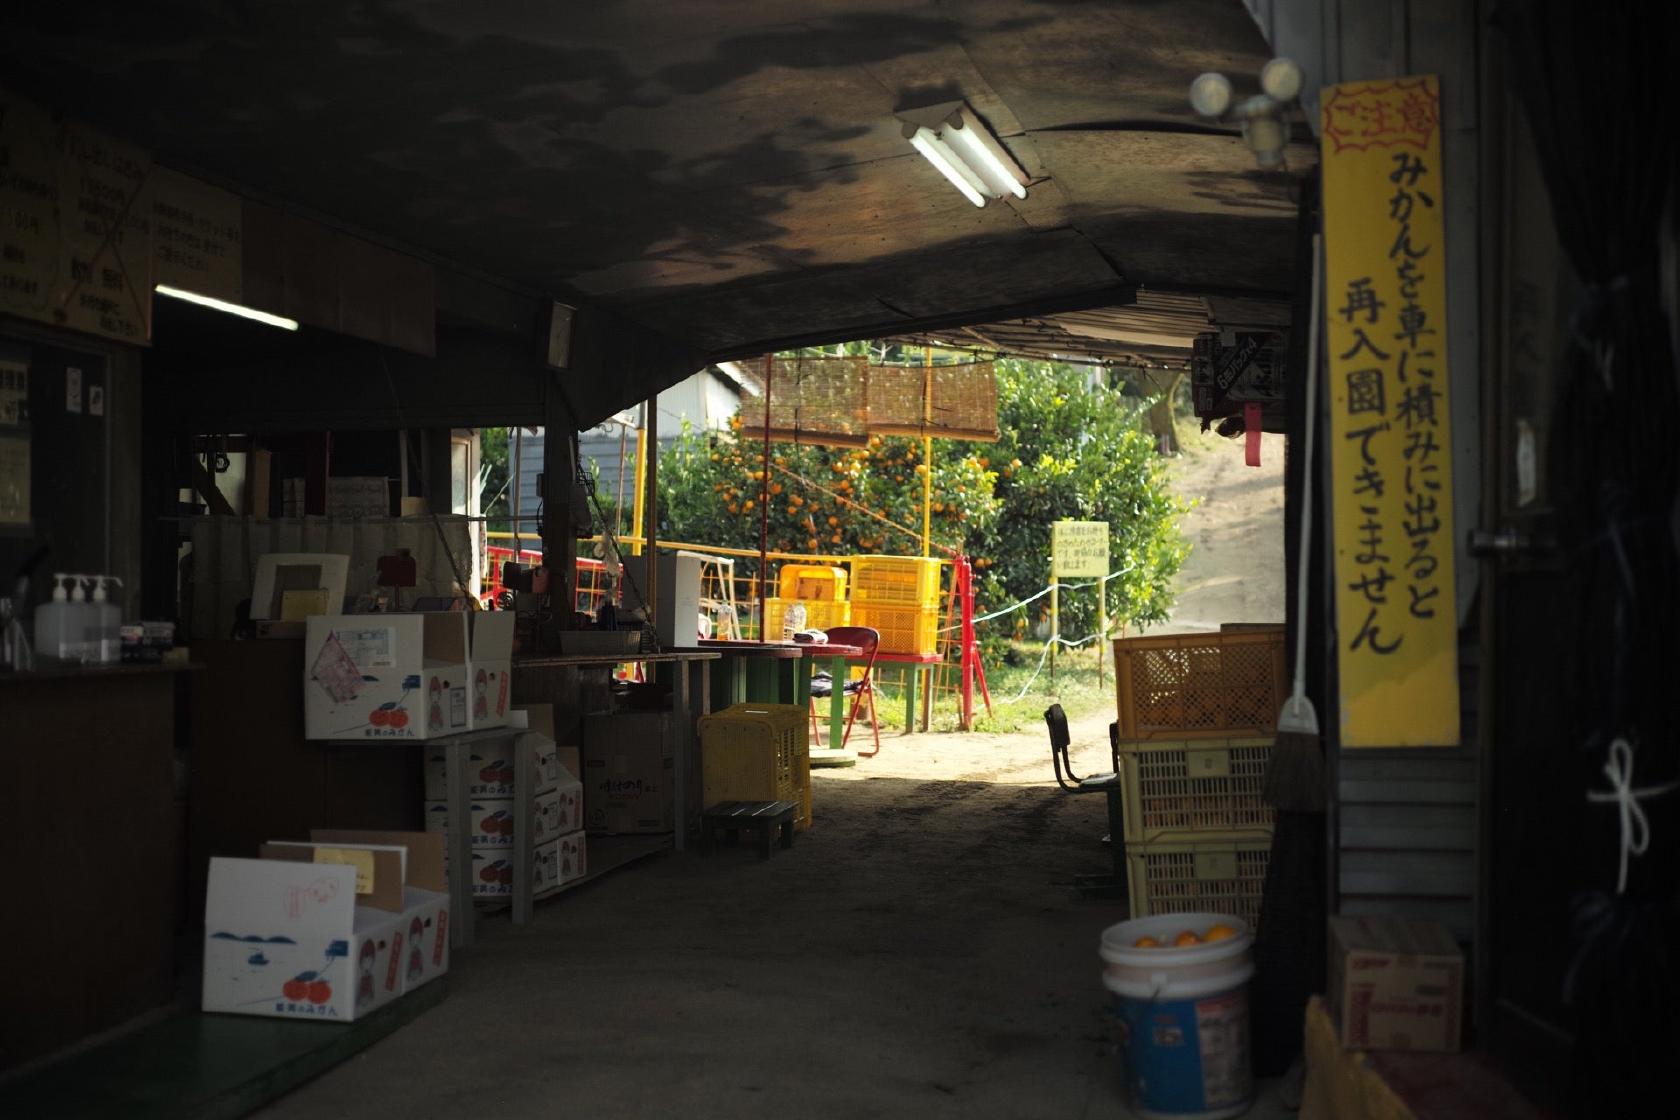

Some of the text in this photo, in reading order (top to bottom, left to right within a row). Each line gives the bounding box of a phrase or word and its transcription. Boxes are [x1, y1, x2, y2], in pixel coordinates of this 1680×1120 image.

[1334, 92, 1432, 135] ご注意
[1339, 277, 1403, 654] 再入園できません
[1389, 152, 1443, 618] みかんを車に積みに出ると
